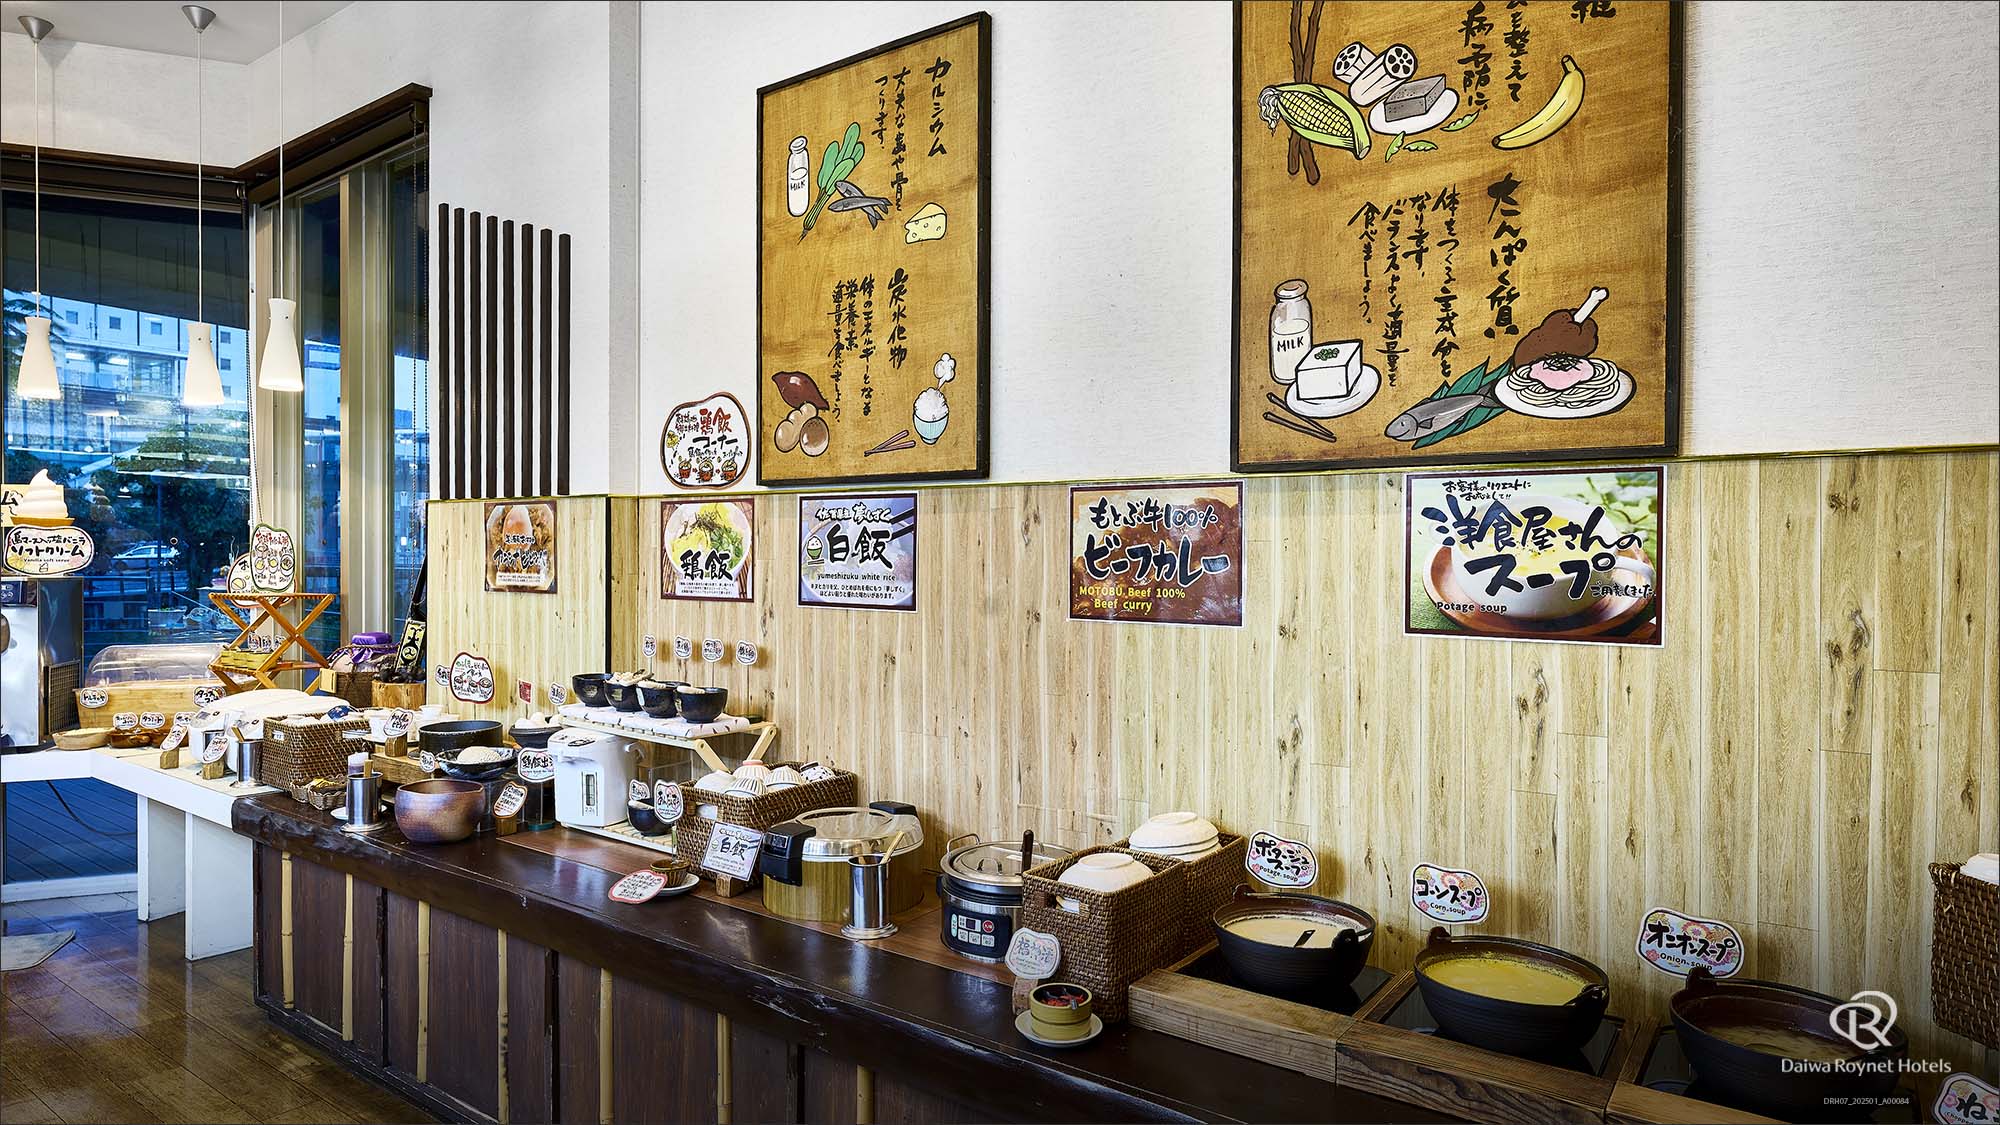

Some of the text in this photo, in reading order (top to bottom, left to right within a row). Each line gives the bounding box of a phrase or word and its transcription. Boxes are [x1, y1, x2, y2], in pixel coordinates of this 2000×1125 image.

[1503, 1, 1531, 102] を整えて
[924, 56, 952, 157] カルシウム
[790, 180, 806, 192] MILK
[1484, 171, 1527, 339] たんぱく質
[1431, 183, 1461, 379] 体をつくる主成分と
[842, 278, 860, 351] 栄養素
[887, 267, 909, 370] 炭水化物
[859, 273, 876, 417] 体のエネルギーとなる
[1276, 334, 1305, 352] MILK
[692, 434, 738, 450] コーナー
[1420, 494, 1643, 553] 洋食屋さんの
[11, 544, 85, 558] ソフトクリーム
[826, 523, 894, 570] 白飯
[1083, 533, 1231, 587] ビーフカレー
[679, 549, 733, 581] 鶏飯
[816, 572, 859, 581] yumeshizuku
[861, 573, 880, 581] white
[1463, 551, 1617, 600] スープ
[1079, 586, 1186, 599] MOTOBU Beef 100%
[1094, 598, 1153, 614] Beef curry
[1436, 602, 1508, 614] Potage soup
[720, 836, 748, 861] 白飯
[1266, 857, 1309, 876] スープ
[1283, 873, 1299, 882] soup
[1416, 879, 1483, 908] コーンスープ
[1449, 907, 1467, 916] soup
[1646, 921, 1736, 962] オニオンスープ
